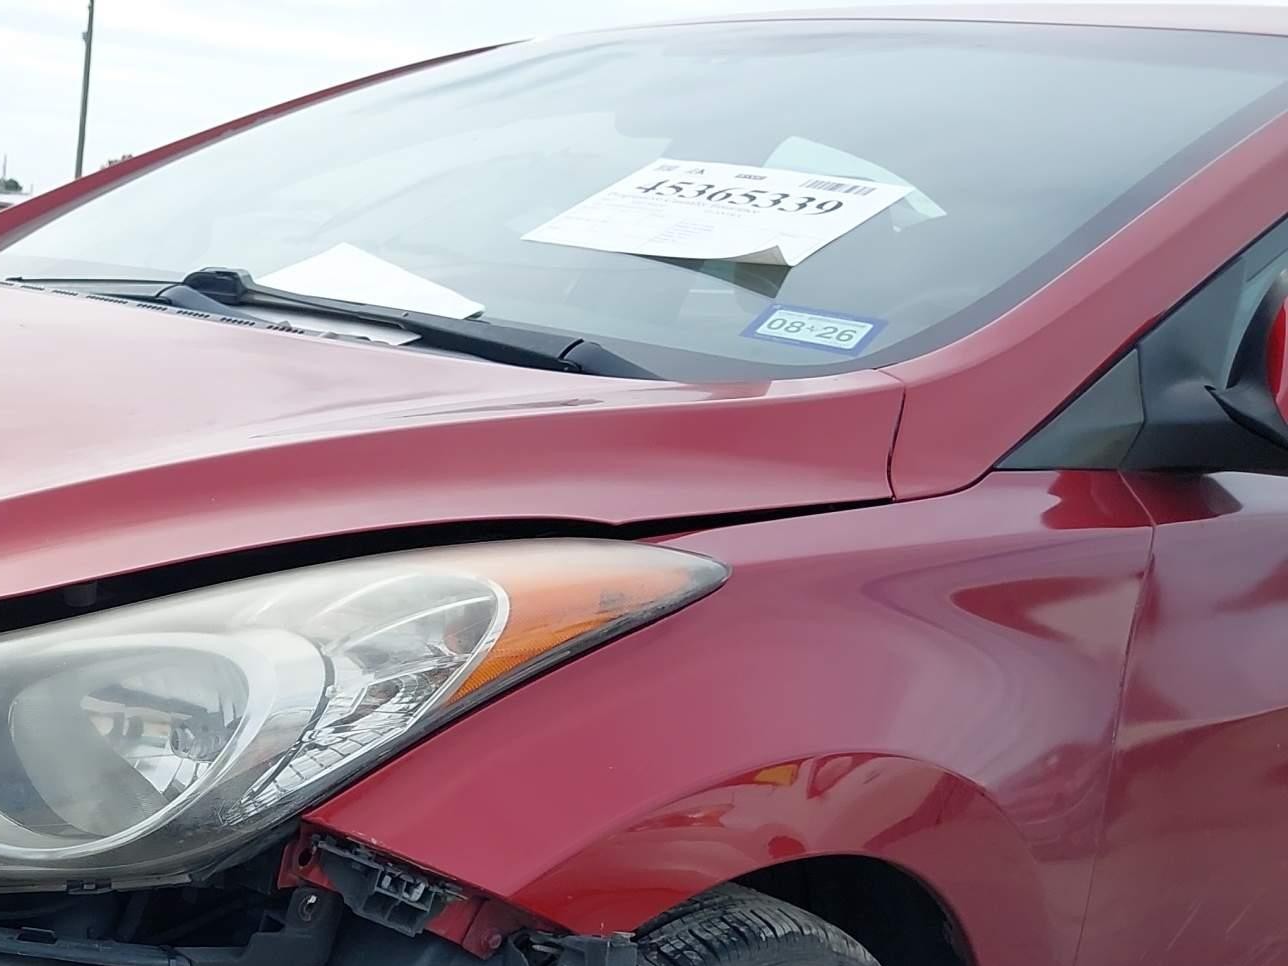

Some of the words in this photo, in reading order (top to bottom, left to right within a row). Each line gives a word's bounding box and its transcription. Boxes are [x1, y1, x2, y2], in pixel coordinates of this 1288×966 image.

[635, 179, 844, 216] 45365339
[767, 318, 807, 333] 08
[815, 325, 857, 342] 26
